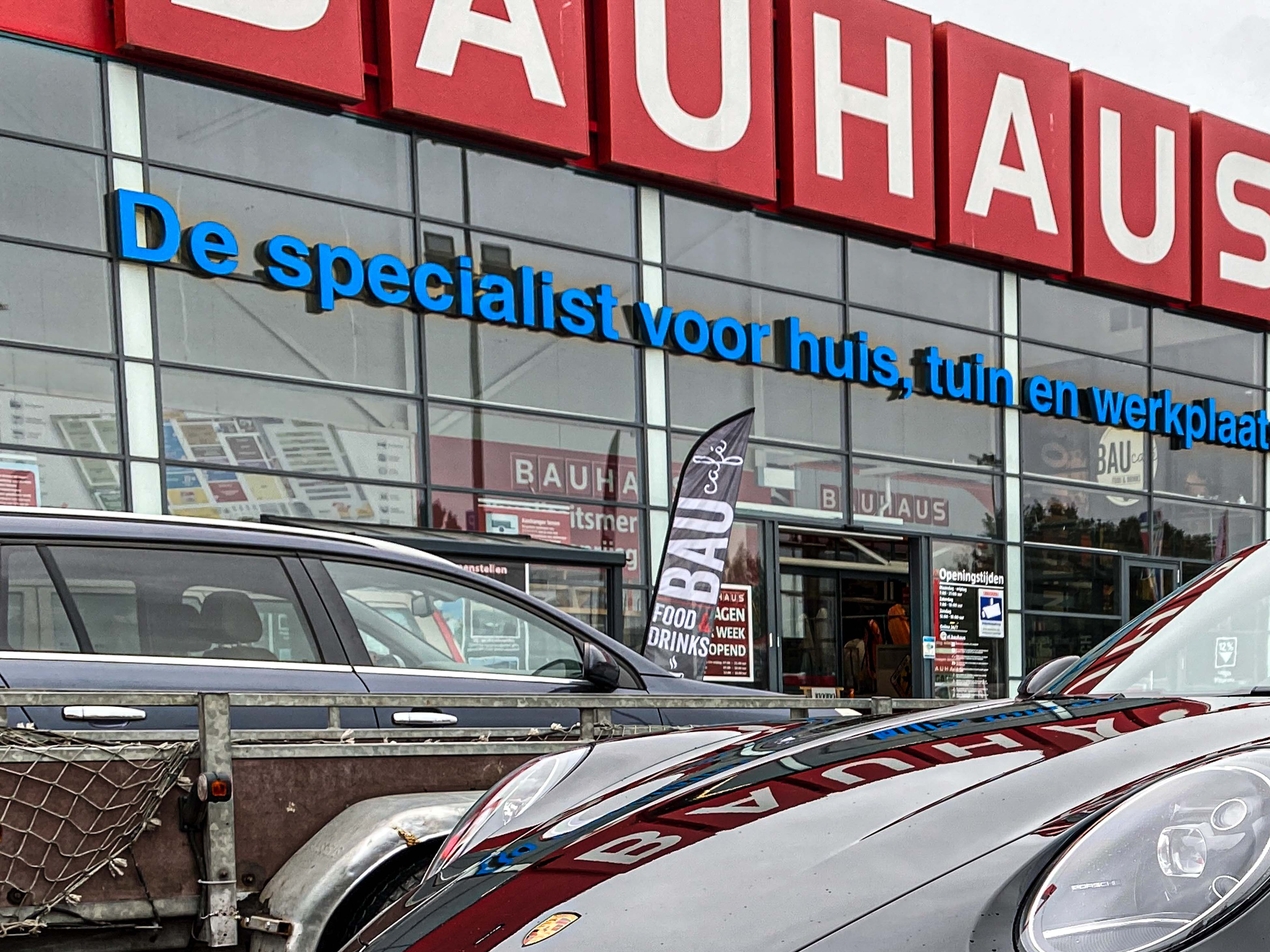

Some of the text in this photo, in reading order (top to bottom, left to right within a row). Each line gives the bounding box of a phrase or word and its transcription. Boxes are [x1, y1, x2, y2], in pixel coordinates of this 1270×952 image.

[115, 188, 239, 276] De
[264, 234, 620, 341] specialist
[634, 301, 772, 366] voor
[788, 315, 913, 399] huis,
[926, 345, 1015, 406] tuin
[1027, 374, 1079, 419] en
[658, 497, 734, 604] BAU
[939, 567, 1004, 586] Openingstijden
[652, 602, 711, 633] FOOD &
[716, 625, 745, 640] WEEK
[647, 626, 710, 657] DRINKS
